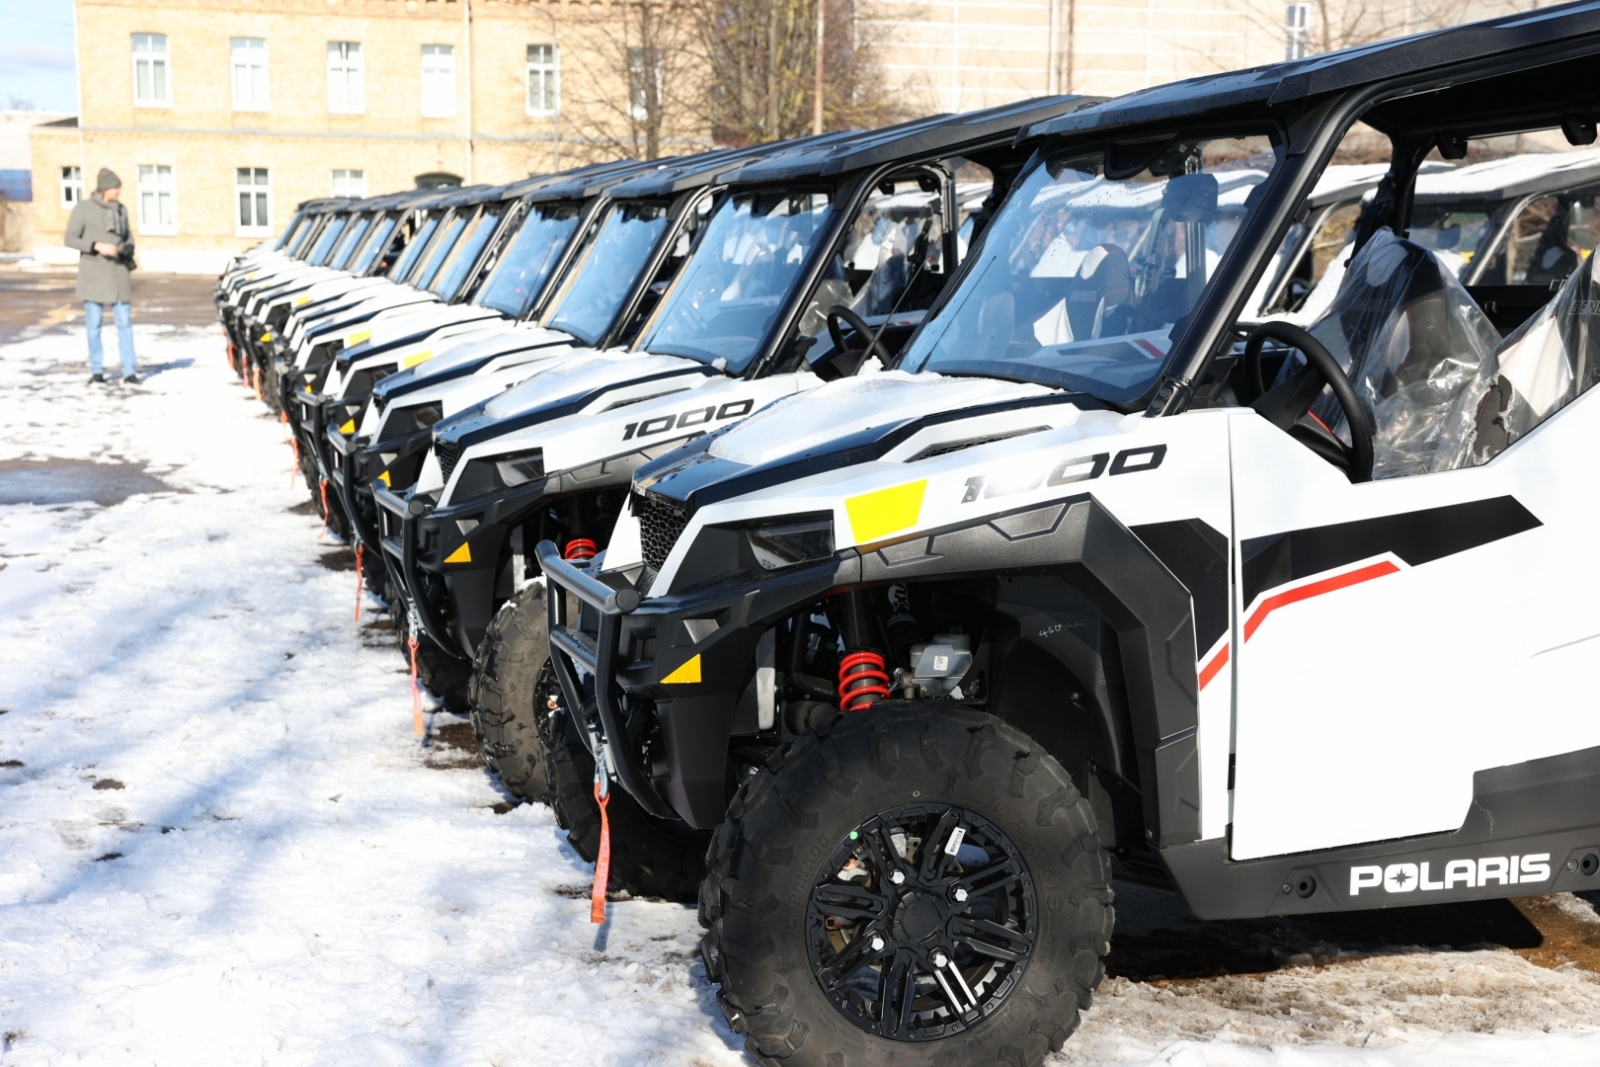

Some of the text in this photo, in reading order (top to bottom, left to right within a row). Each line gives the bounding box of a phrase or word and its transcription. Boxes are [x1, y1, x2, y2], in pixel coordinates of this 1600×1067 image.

[622, 398, 755, 441] 1000
[593, 830, 610, 898] POLARIS
[785, 834, 829, 931] CORONADO
[1350, 853, 1551, 896] POLARIS
